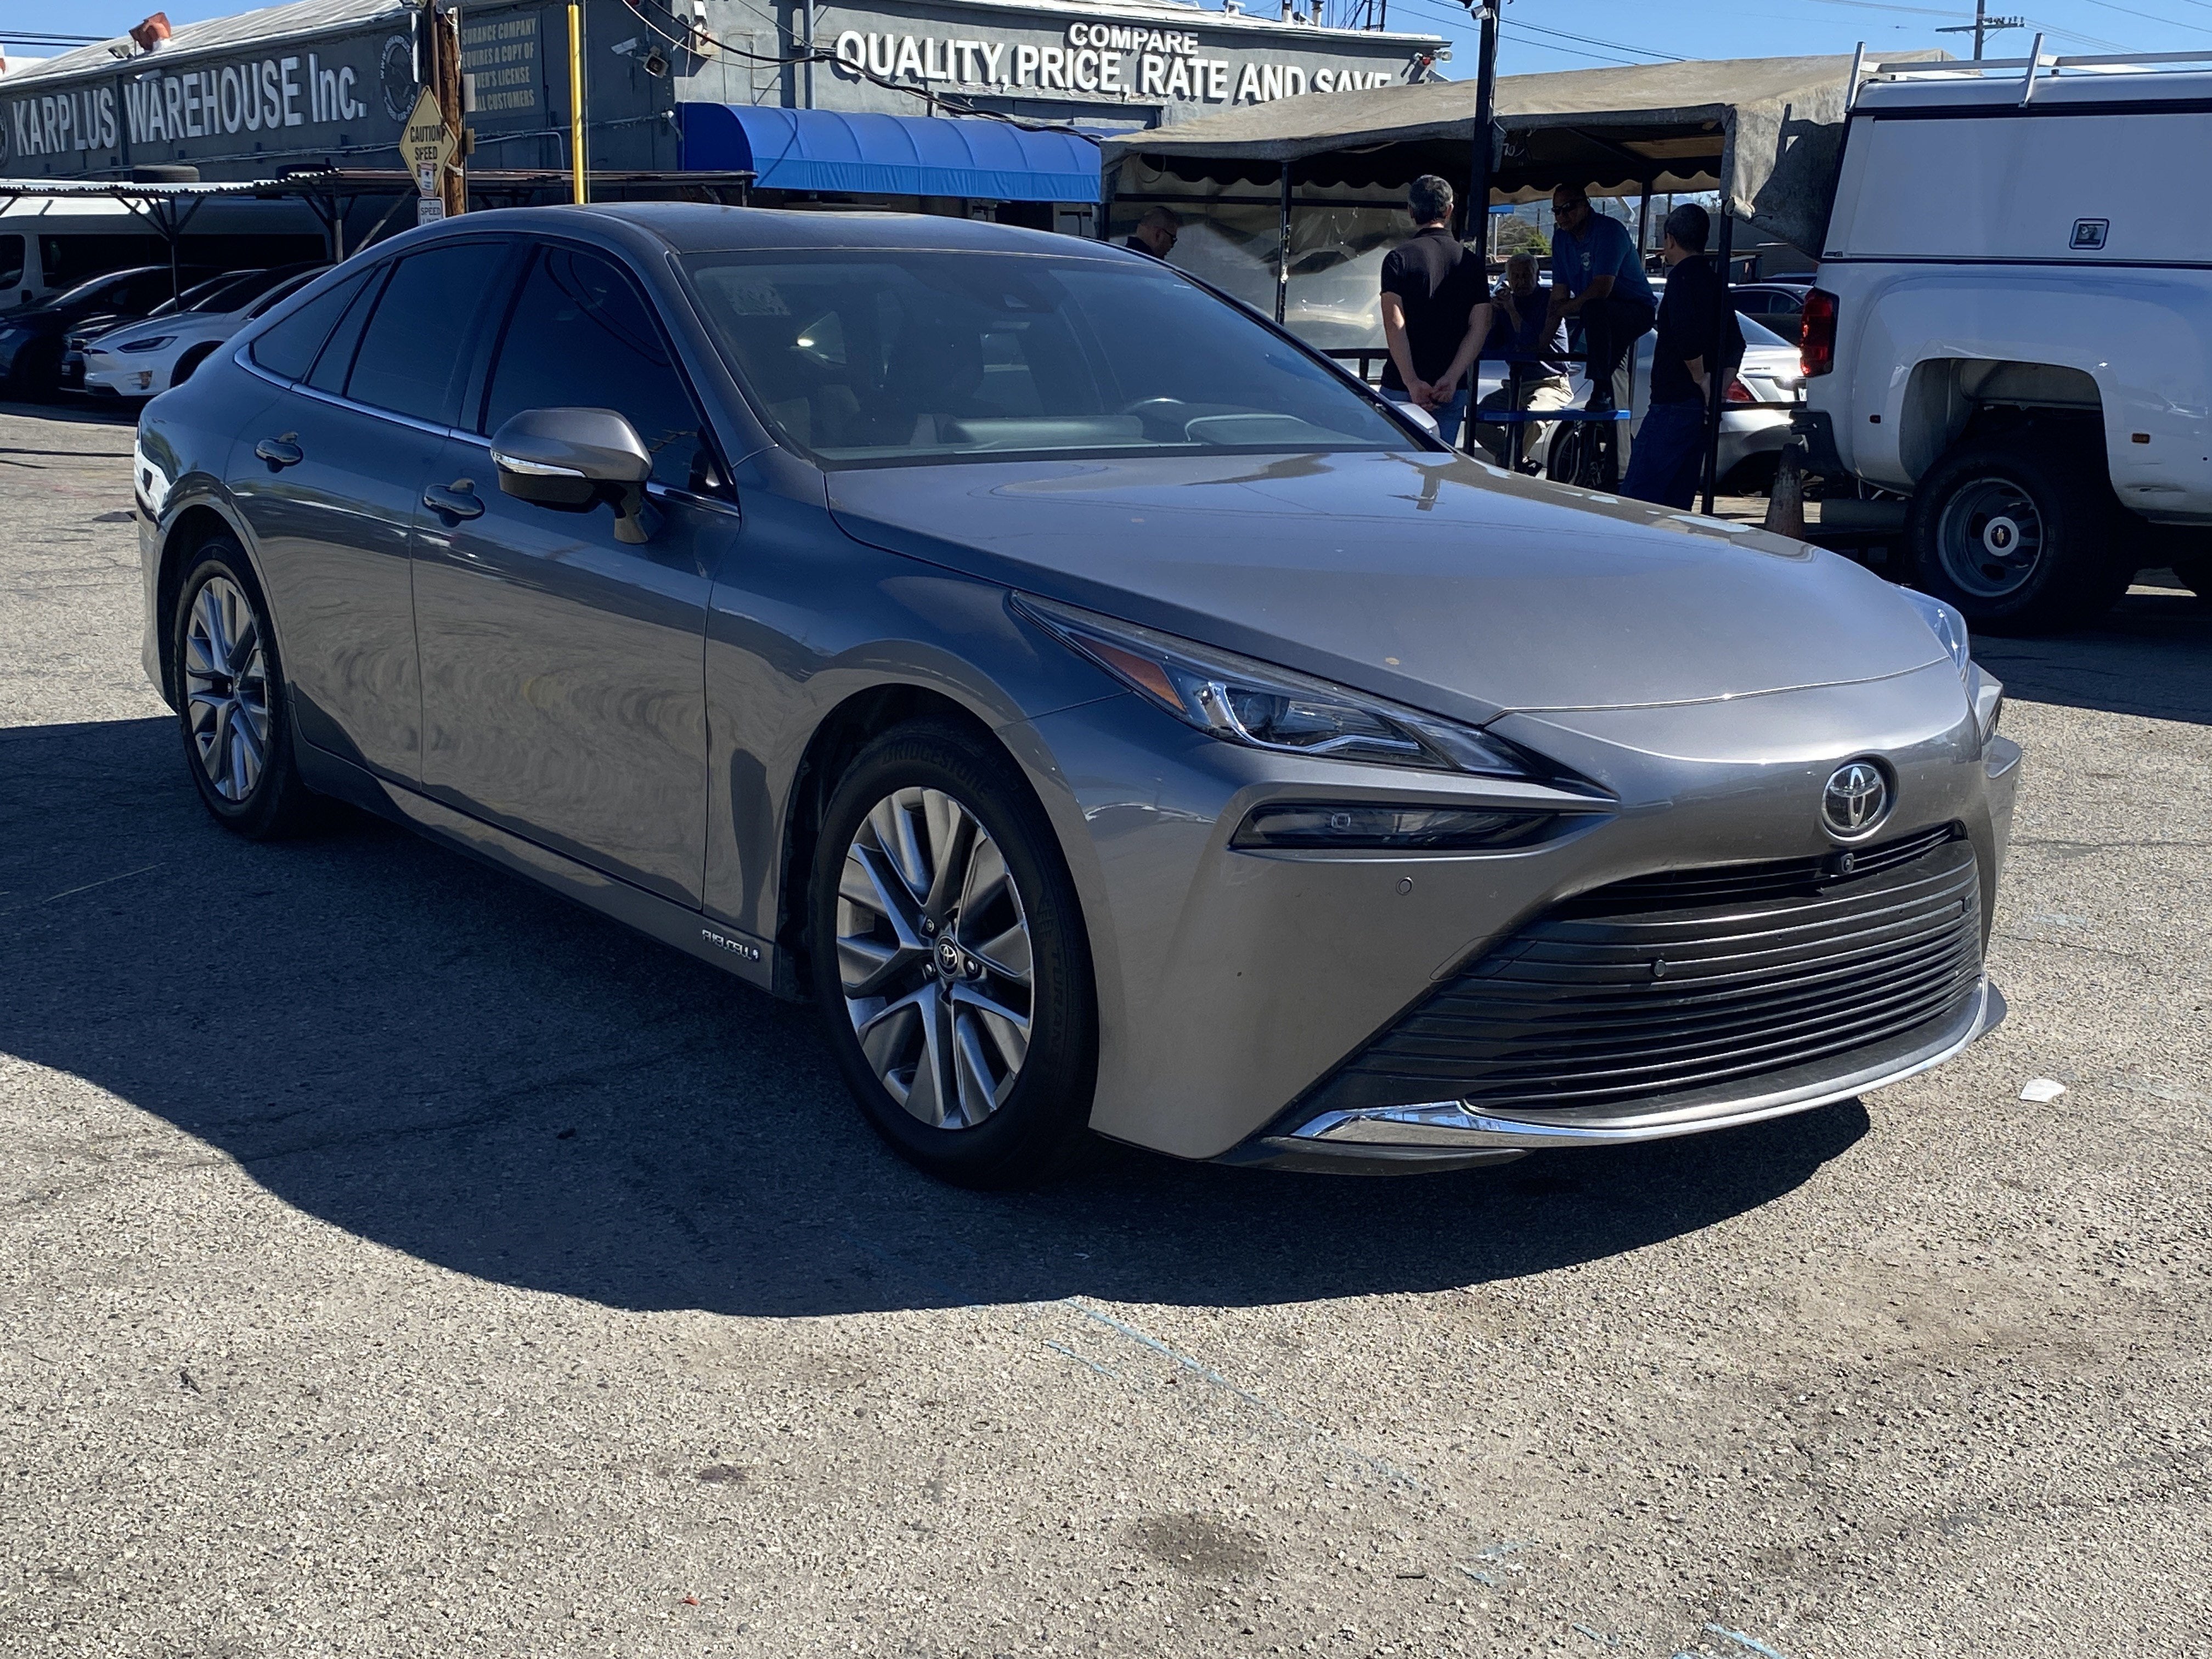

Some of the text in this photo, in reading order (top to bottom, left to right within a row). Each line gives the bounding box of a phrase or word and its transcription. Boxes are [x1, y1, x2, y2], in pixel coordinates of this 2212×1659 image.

[462, 18, 537, 46] SURANCE COMPANY
[1069, 21, 1199, 55] COMPARE
[462, 42, 534, 69] EQUIRES A COPY OF
[836, 30, 1008, 92] QUALITY,
[1015, 44, 1130, 101] PRICE,
[1142, 54, 1228, 99] RATE
[1238, 63, 1306, 101] AND
[498, 66, 530, 86] LICENSE
[12, 87, 117, 157] KARPLUS
[124, 55, 305, 144] WAREHOUSE
[309, 53, 367, 123] Inc.
[487, 89, 535, 111] CUSTOMERS
[410, 125, 442, 143] CAUTION
[415, 146, 438, 161] SPEED
[421, 207, 441, 215] SPEED
